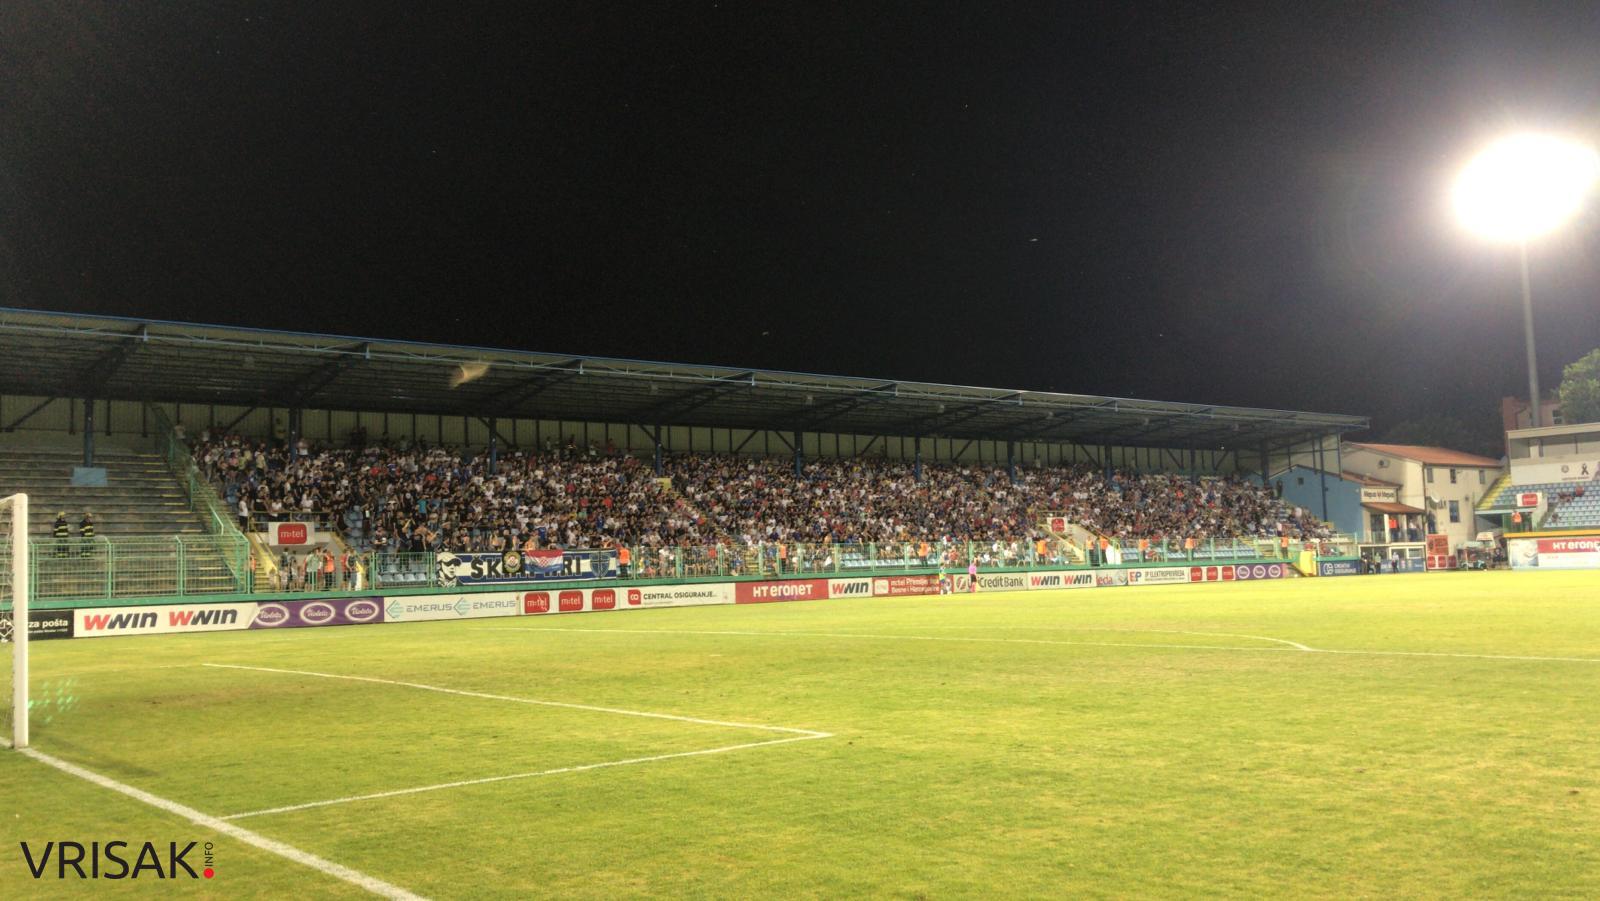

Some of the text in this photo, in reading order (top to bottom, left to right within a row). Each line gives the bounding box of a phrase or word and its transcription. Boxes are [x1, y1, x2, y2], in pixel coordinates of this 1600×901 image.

[643, 592, 672, 600] CENTRAL
[753, 586, 768, 597] HT
[406, 600, 516, 613] EMERUS EMERUS
[42, 618, 68, 629] pošta
